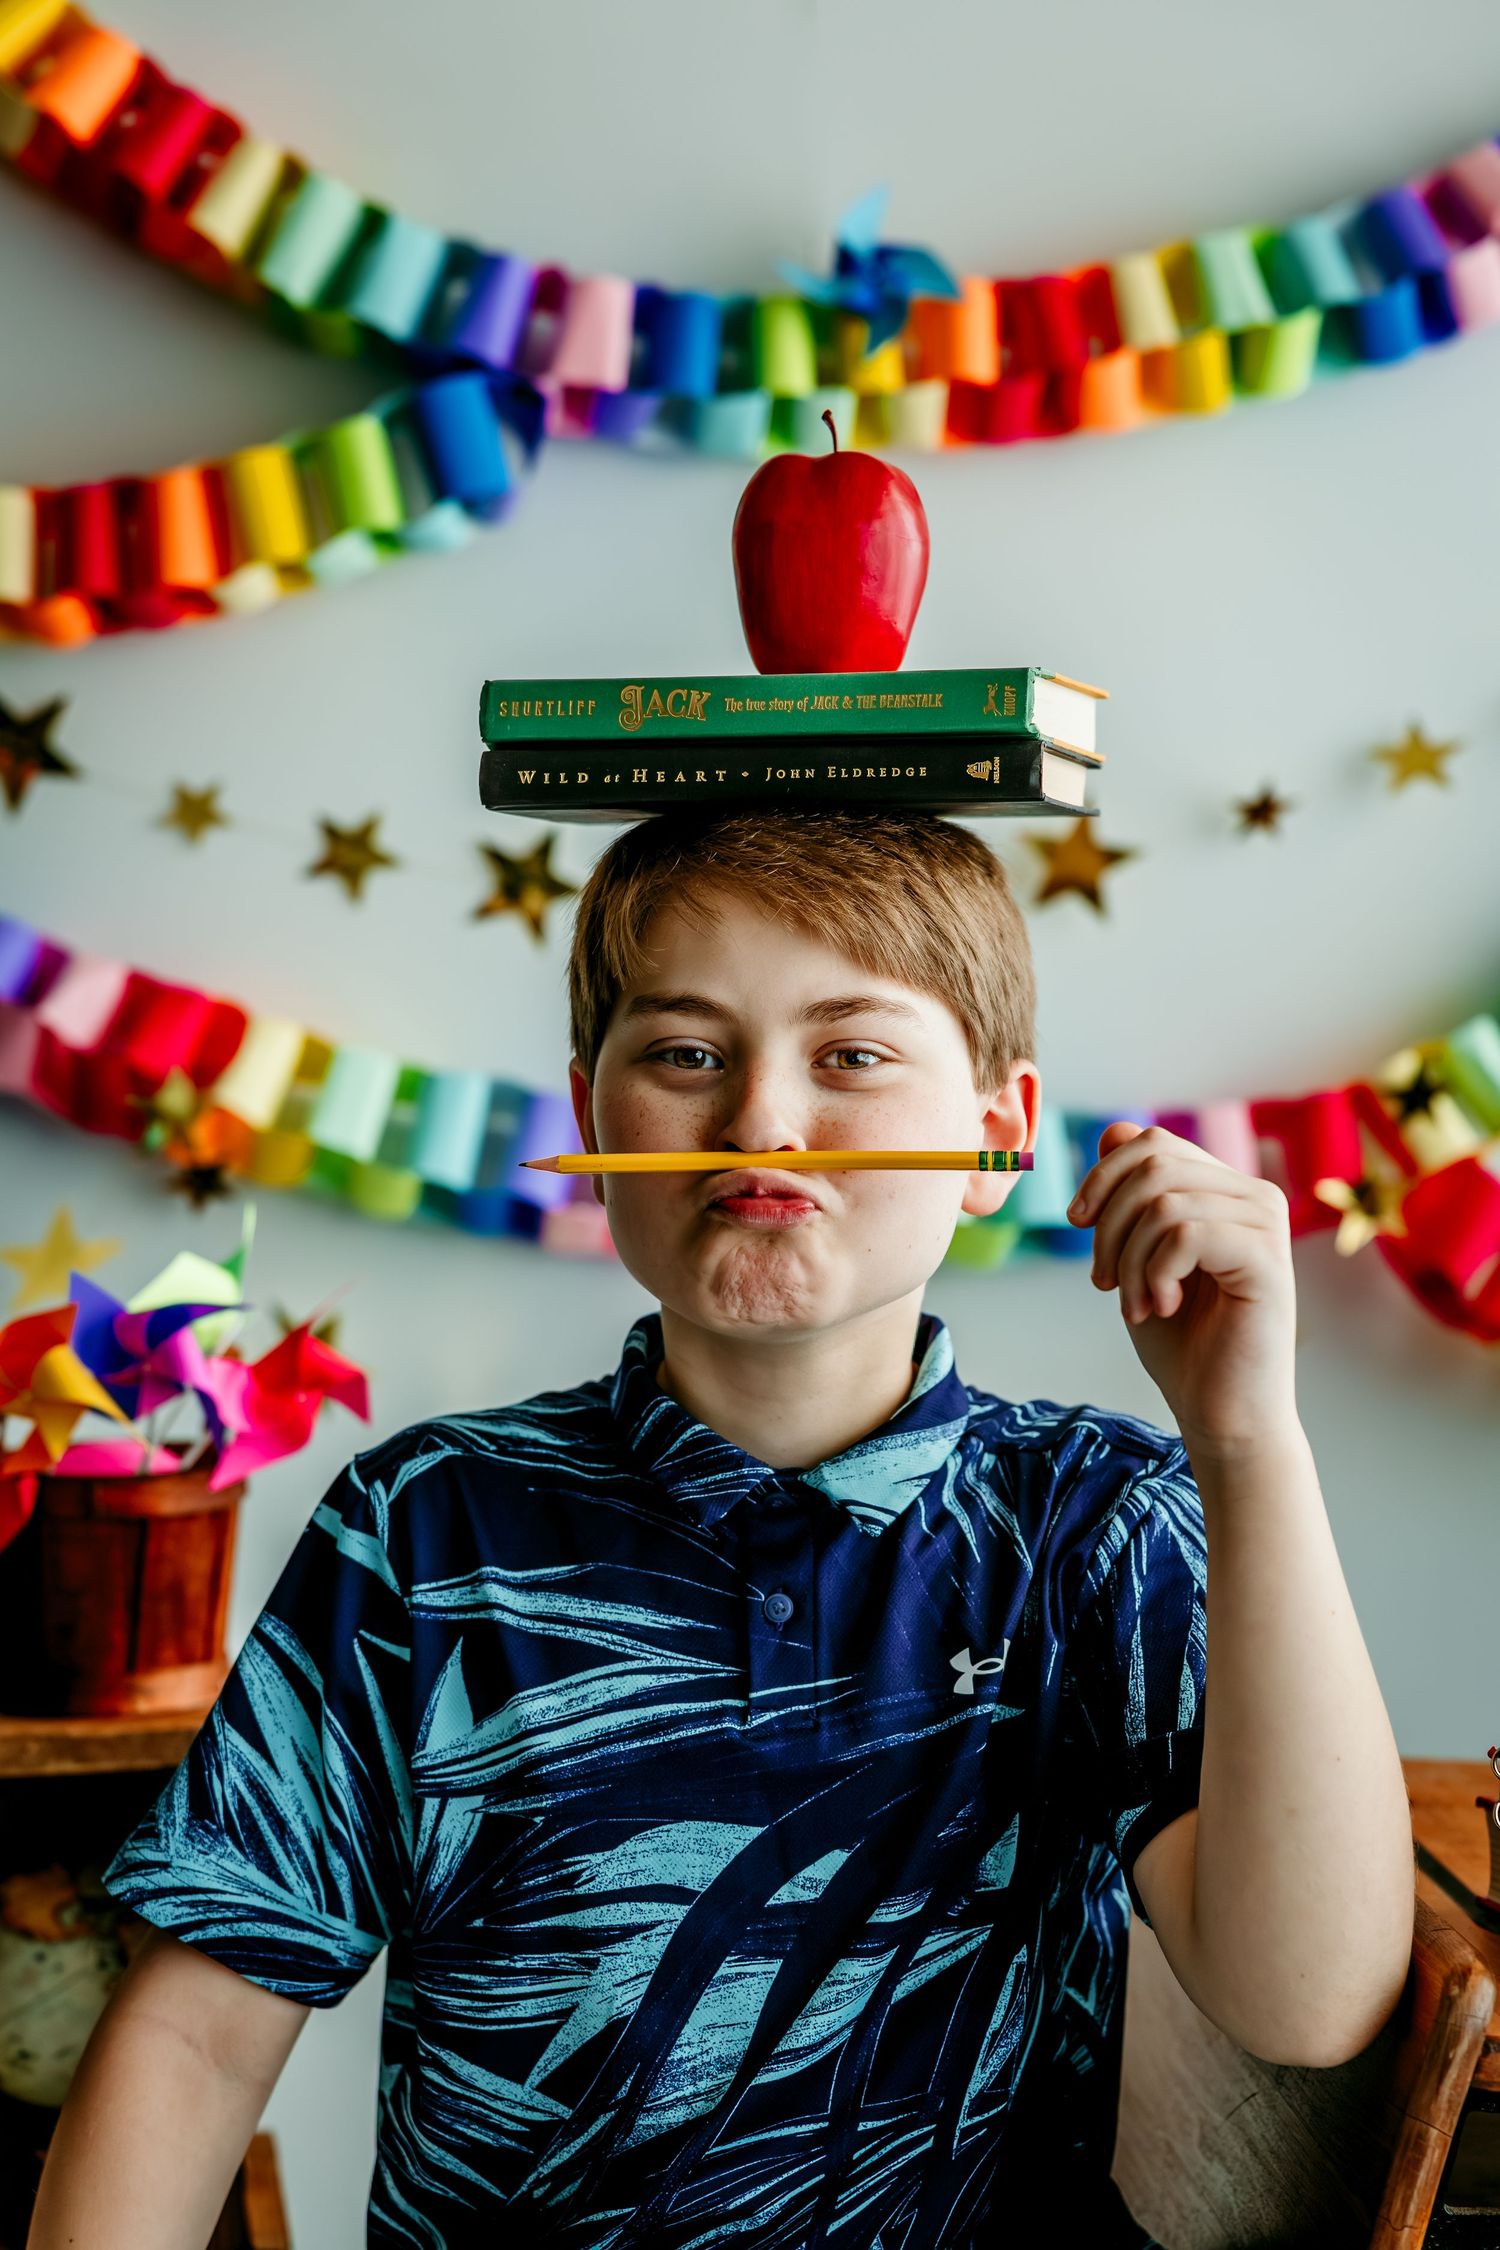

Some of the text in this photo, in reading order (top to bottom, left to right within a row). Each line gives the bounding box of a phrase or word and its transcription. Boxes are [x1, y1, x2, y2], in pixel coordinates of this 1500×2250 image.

[499, 699, 597, 718] SHURTLIFF
[618, 684, 712, 732] JACK
[724, 692, 944, 713] The true story of JACK & THE BEANSTALK
[1003, 685, 1017, 717] KNOPF
[517, 765, 928, 785] WILD at HEART JOHN ELDREDGE
[993, 756, 1001, 784] NELSON
